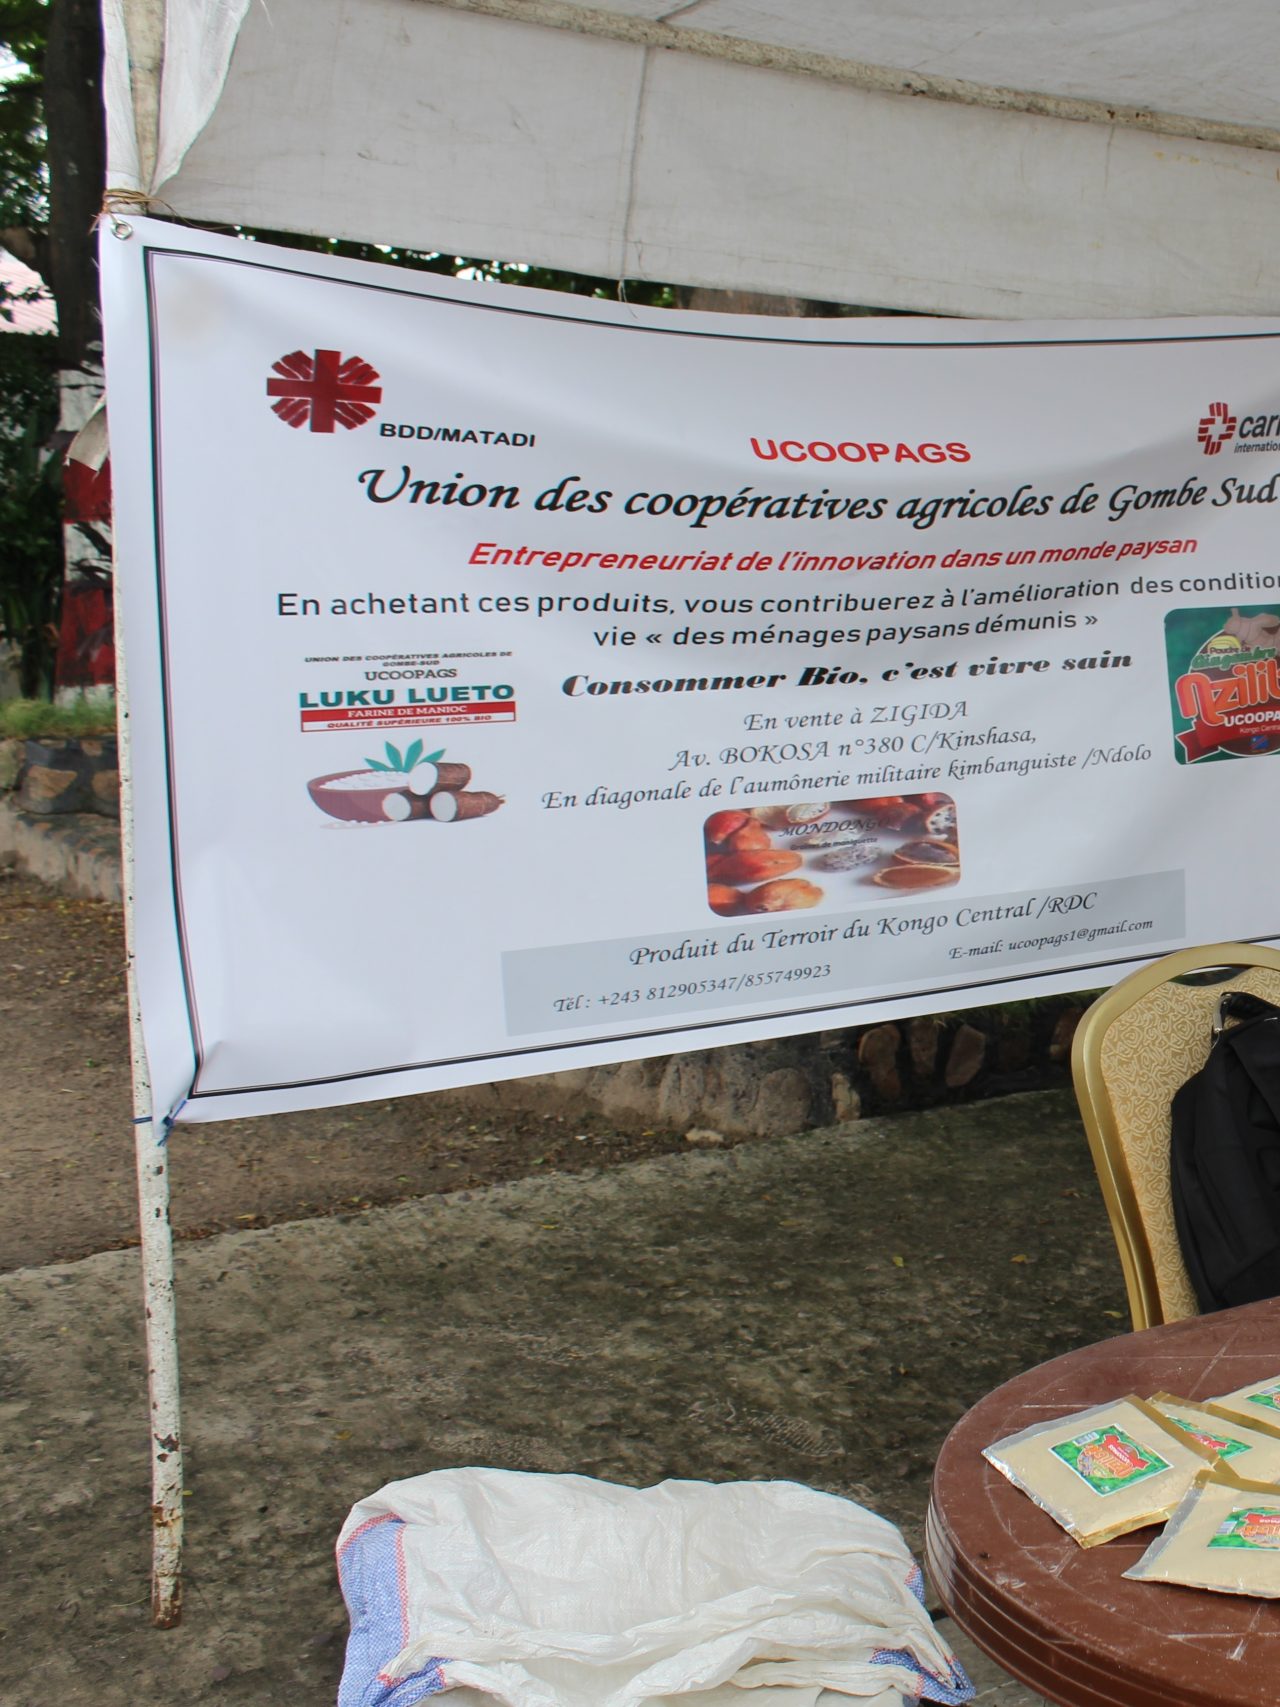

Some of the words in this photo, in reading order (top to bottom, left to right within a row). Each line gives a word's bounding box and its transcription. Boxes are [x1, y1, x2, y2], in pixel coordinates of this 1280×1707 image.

[380, 423, 535, 447] BDD/MATADI
[750, 438, 971, 463] UCOOPAGS
[358, 465, 519, 509] Union
[534, 476, 613, 513] des
[624, 487, 888, 528] coopératives
[896, 485, 1054, 530] agricoles
[1060, 483, 1099, 514] de
[1108, 477, 1207, 521] Gombe
[468, 543, 733, 572] Entrepreneuriat
[736, 551, 773, 571] de
[941, 549, 1003, 568] dans
[1005, 550, 1036, 565] un
[1038, 541, 1116, 563] monde
[1115, 539, 1197, 561] paysan
[278, 593, 320, 615] En
[331, 593, 469, 615] achetant
[479, 597, 529, 612] ces
[538, 593, 674, 617] produits,
[685, 600, 753, 613] vous
[761, 594, 935, 612] contribuerez
[941, 588, 954, 607] à
[1131, 576, 1173, 594] des
[594, 626, 636, 646] vie
[673, 627, 724, 645] des
[732, 624, 861, 647] ménages
[866, 623, 970, 646] paysans
[975, 611, 1076, 634] démunis
[365, 668, 458, 681] UCOOPAGS
[562, 675, 786, 696] Consommer
[798, 667, 868, 686] Bio,
[968, 656, 1050, 676] vivre
[1062, 650, 1131, 670] sain
[300, 689, 395, 708] LUKU
[408, 684, 515, 703] LUETO
[348, 709, 395, 718] FARINE
[398, 708, 413, 716] DE
[415, 706, 467, 714] MANIOC
[744, 714, 777, 731] En
[785, 712, 843, 728] vente
[850, 707, 863, 724] à
[870, 701, 967, 727] ZIGIDA
[668, 750, 710, 771] Av.
[719, 741, 829, 764] BOKOSA
[839, 736, 904, 756] n°380
[911, 726, 1036, 754] C/Kinshasa,
[542, 792, 577, 809] En
[585, 780, 691, 809] diagonale
[699, 778, 722, 797] de
[857, 765, 941, 784] militaire
[948, 753, 1076, 780] kimbanguiste
[1081, 744, 1151, 769] /Ndolo
[778, 816, 889, 837] MONDONGO
[630, 939, 718, 965] Produit
[727, 933, 754, 953] du
[762, 925, 838, 948] Terroir
[843, 919, 870, 939] du
[877, 916, 948, 936] Kongo
[956, 898, 1036, 926] Central
[1036, 892, 1097, 919] /RDC
[1009, 920, 1152, 950] ucoopags1@gmail.com
[553, 995, 584, 1012] Tél
[598, 990, 640, 1005] +243
[646, 965, 830, 1000] 812905347/855749923
